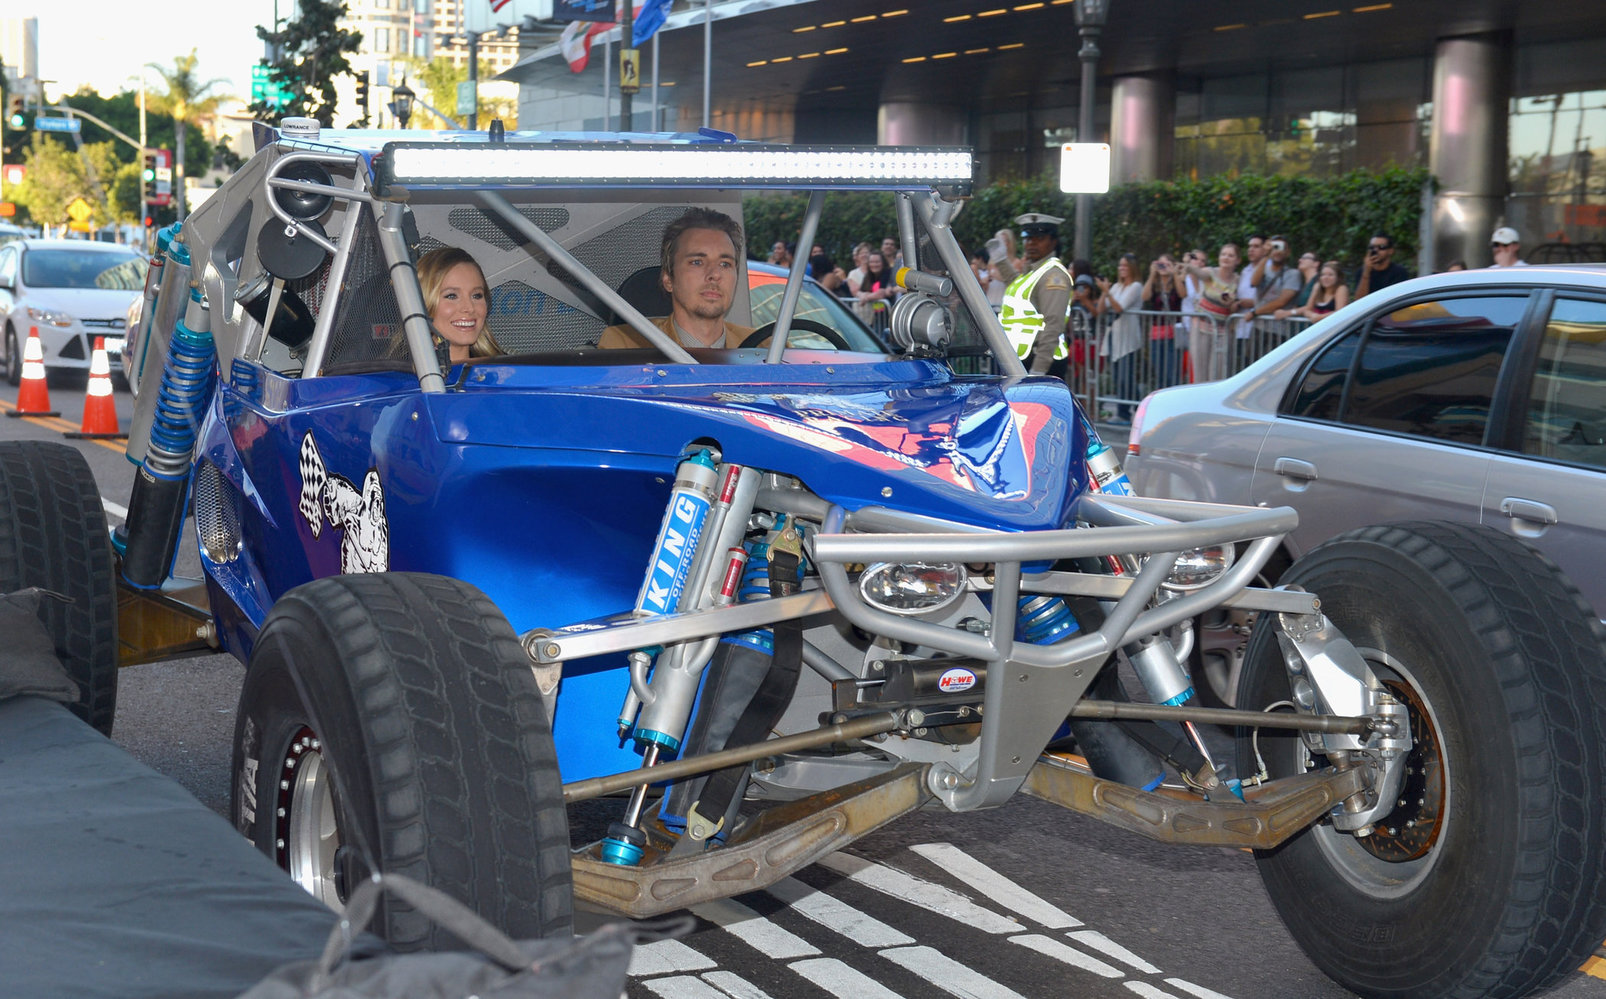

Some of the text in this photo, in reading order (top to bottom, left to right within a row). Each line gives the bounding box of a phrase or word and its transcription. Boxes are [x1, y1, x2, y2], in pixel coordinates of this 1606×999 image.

[284, 122, 309, 130] LOWRANCE
[647, 495, 697, 610] KING
[672, 528, 699, 598] OFF-ROAD
[940, 676, 974, 688] HOWE
